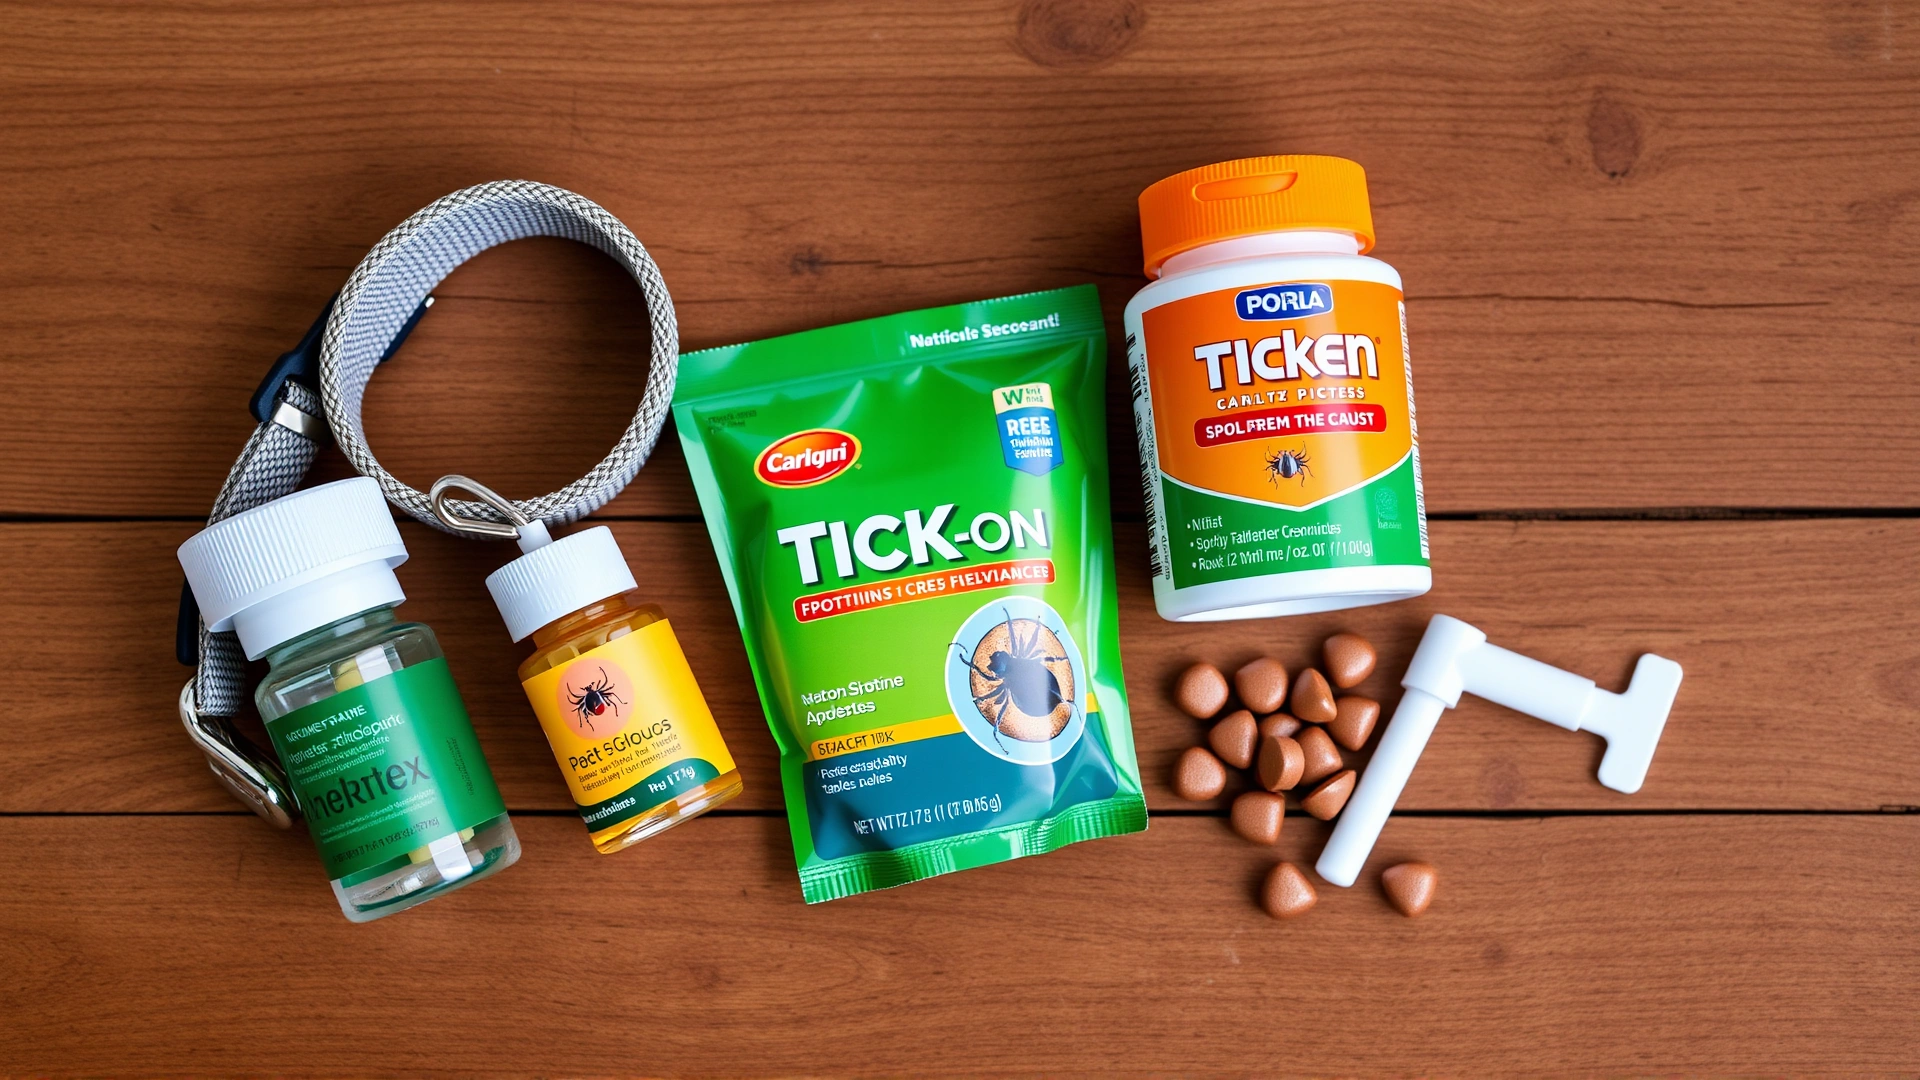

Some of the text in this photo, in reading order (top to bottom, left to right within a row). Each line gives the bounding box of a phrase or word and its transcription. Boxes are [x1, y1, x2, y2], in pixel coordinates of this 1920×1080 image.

[1294, 412, 1325, 429] THE
[1328, 412, 1374, 426] CAUST
[777, 504, 1050, 585] TICK-ON
